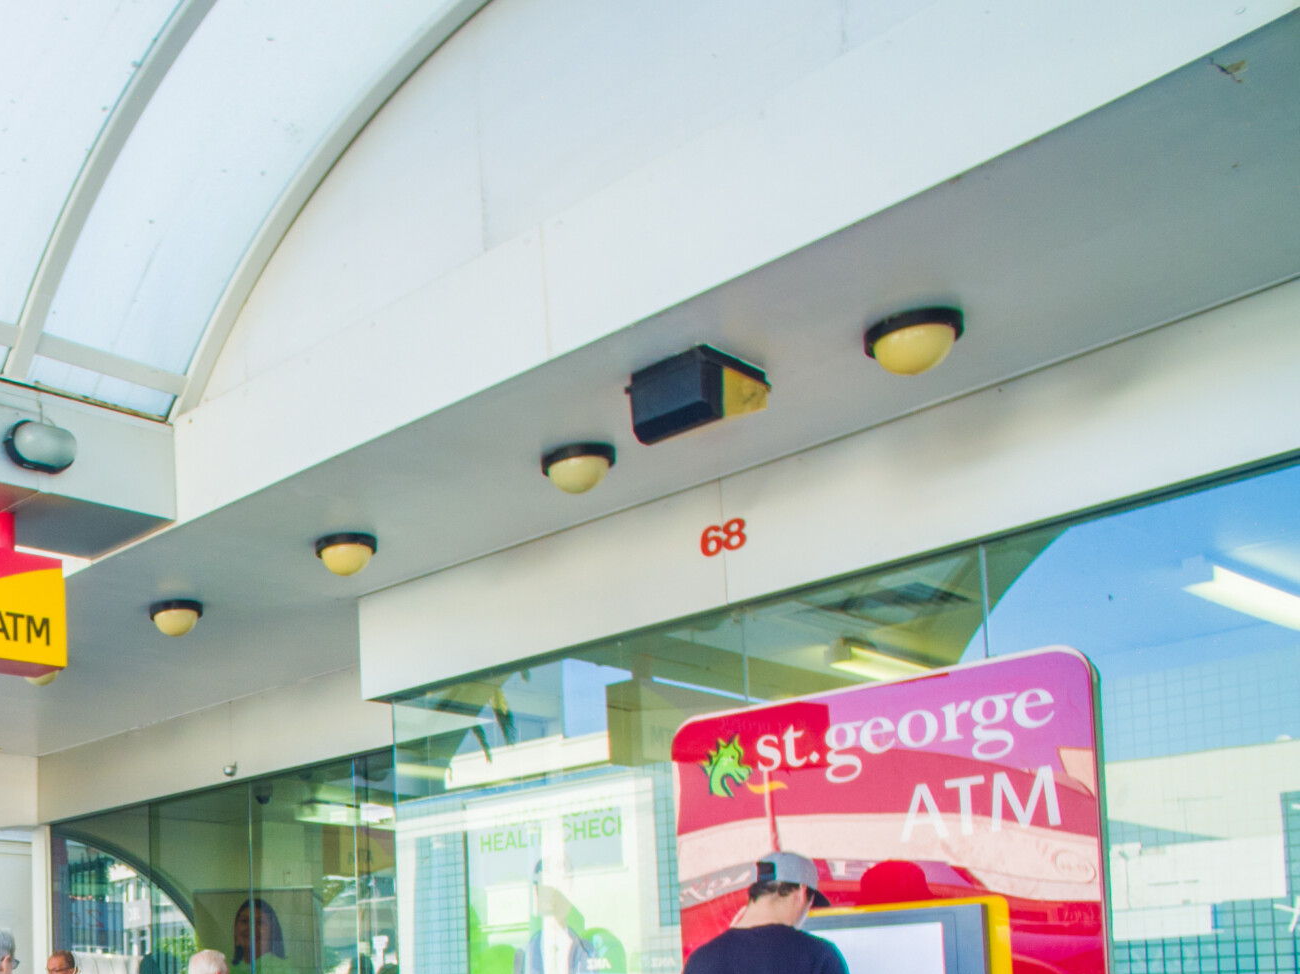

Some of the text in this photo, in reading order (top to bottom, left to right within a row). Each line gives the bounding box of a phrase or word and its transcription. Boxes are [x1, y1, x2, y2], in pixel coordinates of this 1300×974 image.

[700, 518, 747, 557] 68
[755, 687, 1055, 783] st.george
[901, 766, 1062, 842] ATM
